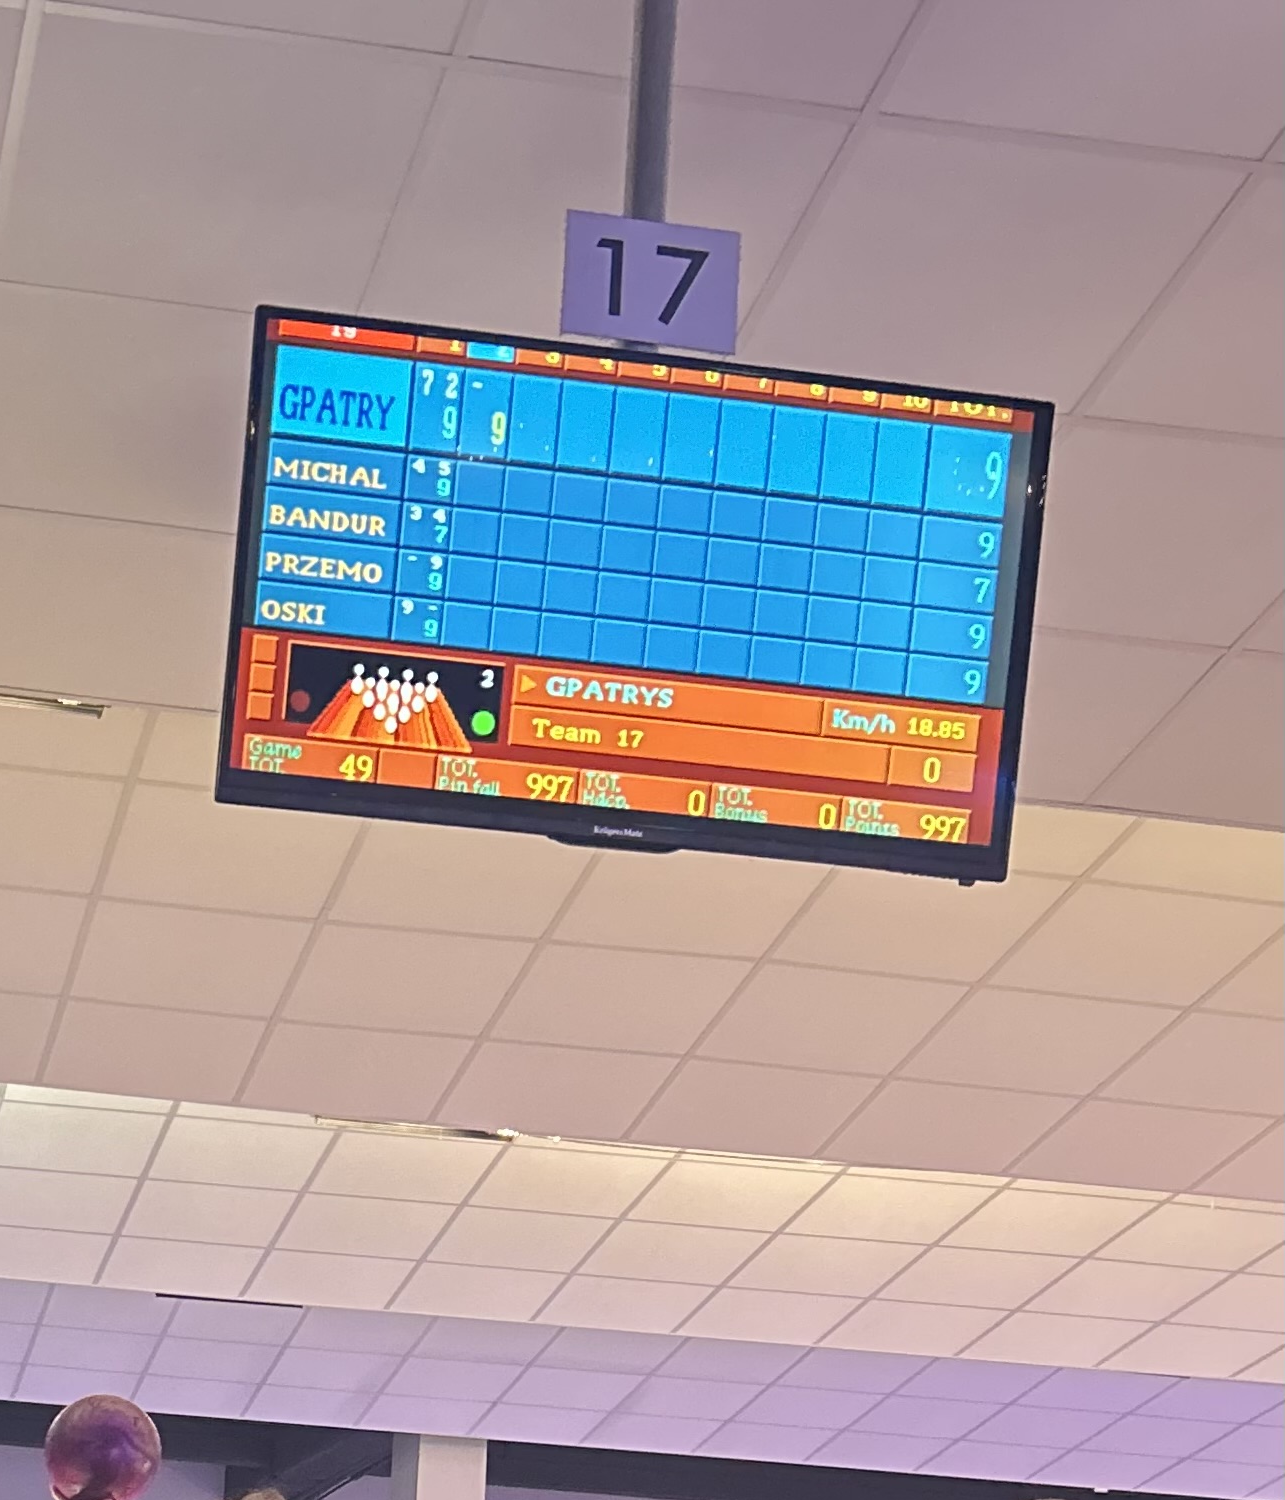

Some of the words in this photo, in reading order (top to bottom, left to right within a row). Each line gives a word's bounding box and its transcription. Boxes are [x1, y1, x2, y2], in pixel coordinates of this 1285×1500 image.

[596, 238, 711, 325] 17
[279, 382, 397, 432] GPATRY
[422, 367, 435, 397] 7
[445, 371, 460, 400] 2
[985, 450, 1005, 500] 9
[441, 405, 458, 440] 9
[490, 410, 507, 446] 9
[435, 477, 452, 498] 9
[272, 456, 387, 491] MICHAL
[977, 530, 997, 560] 9
[433, 524, 449, 545] 7
[268, 504, 386, 538] BANDUR
[972, 576, 992, 604] 7
[427, 571, 444, 592] 9
[264, 551, 383, 584] PRZEMO
[967, 622, 987, 651] 9
[423, 618, 439, 639] 9
[259, 600, 327, 628] OSKI
[963, 668, 982, 697] 9
[479, 668, 496, 690] 2
[545, 674, 675, 710] GPATRYS
[831, 708, 897, 736] Km/h
[906, 715, 968, 741] 18.85
[249, 737, 303, 760] Game
[531, 716, 602, 746] Team
[616, 728, 645, 750] 17
[922, 756, 942, 784] 0
[338, 752, 375, 783] 49
[440, 756, 479, 779] TOT.
[584, 771, 622, 793] TOT.
[525, 771, 575, 803] 997
[716, 785, 753, 807] TOT.
[686, 789, 707, 817] 0
[817, 802, 837, 831] 0
[847, 799, 885, 820] TOT.
[919, 813, 967, 843] 997
